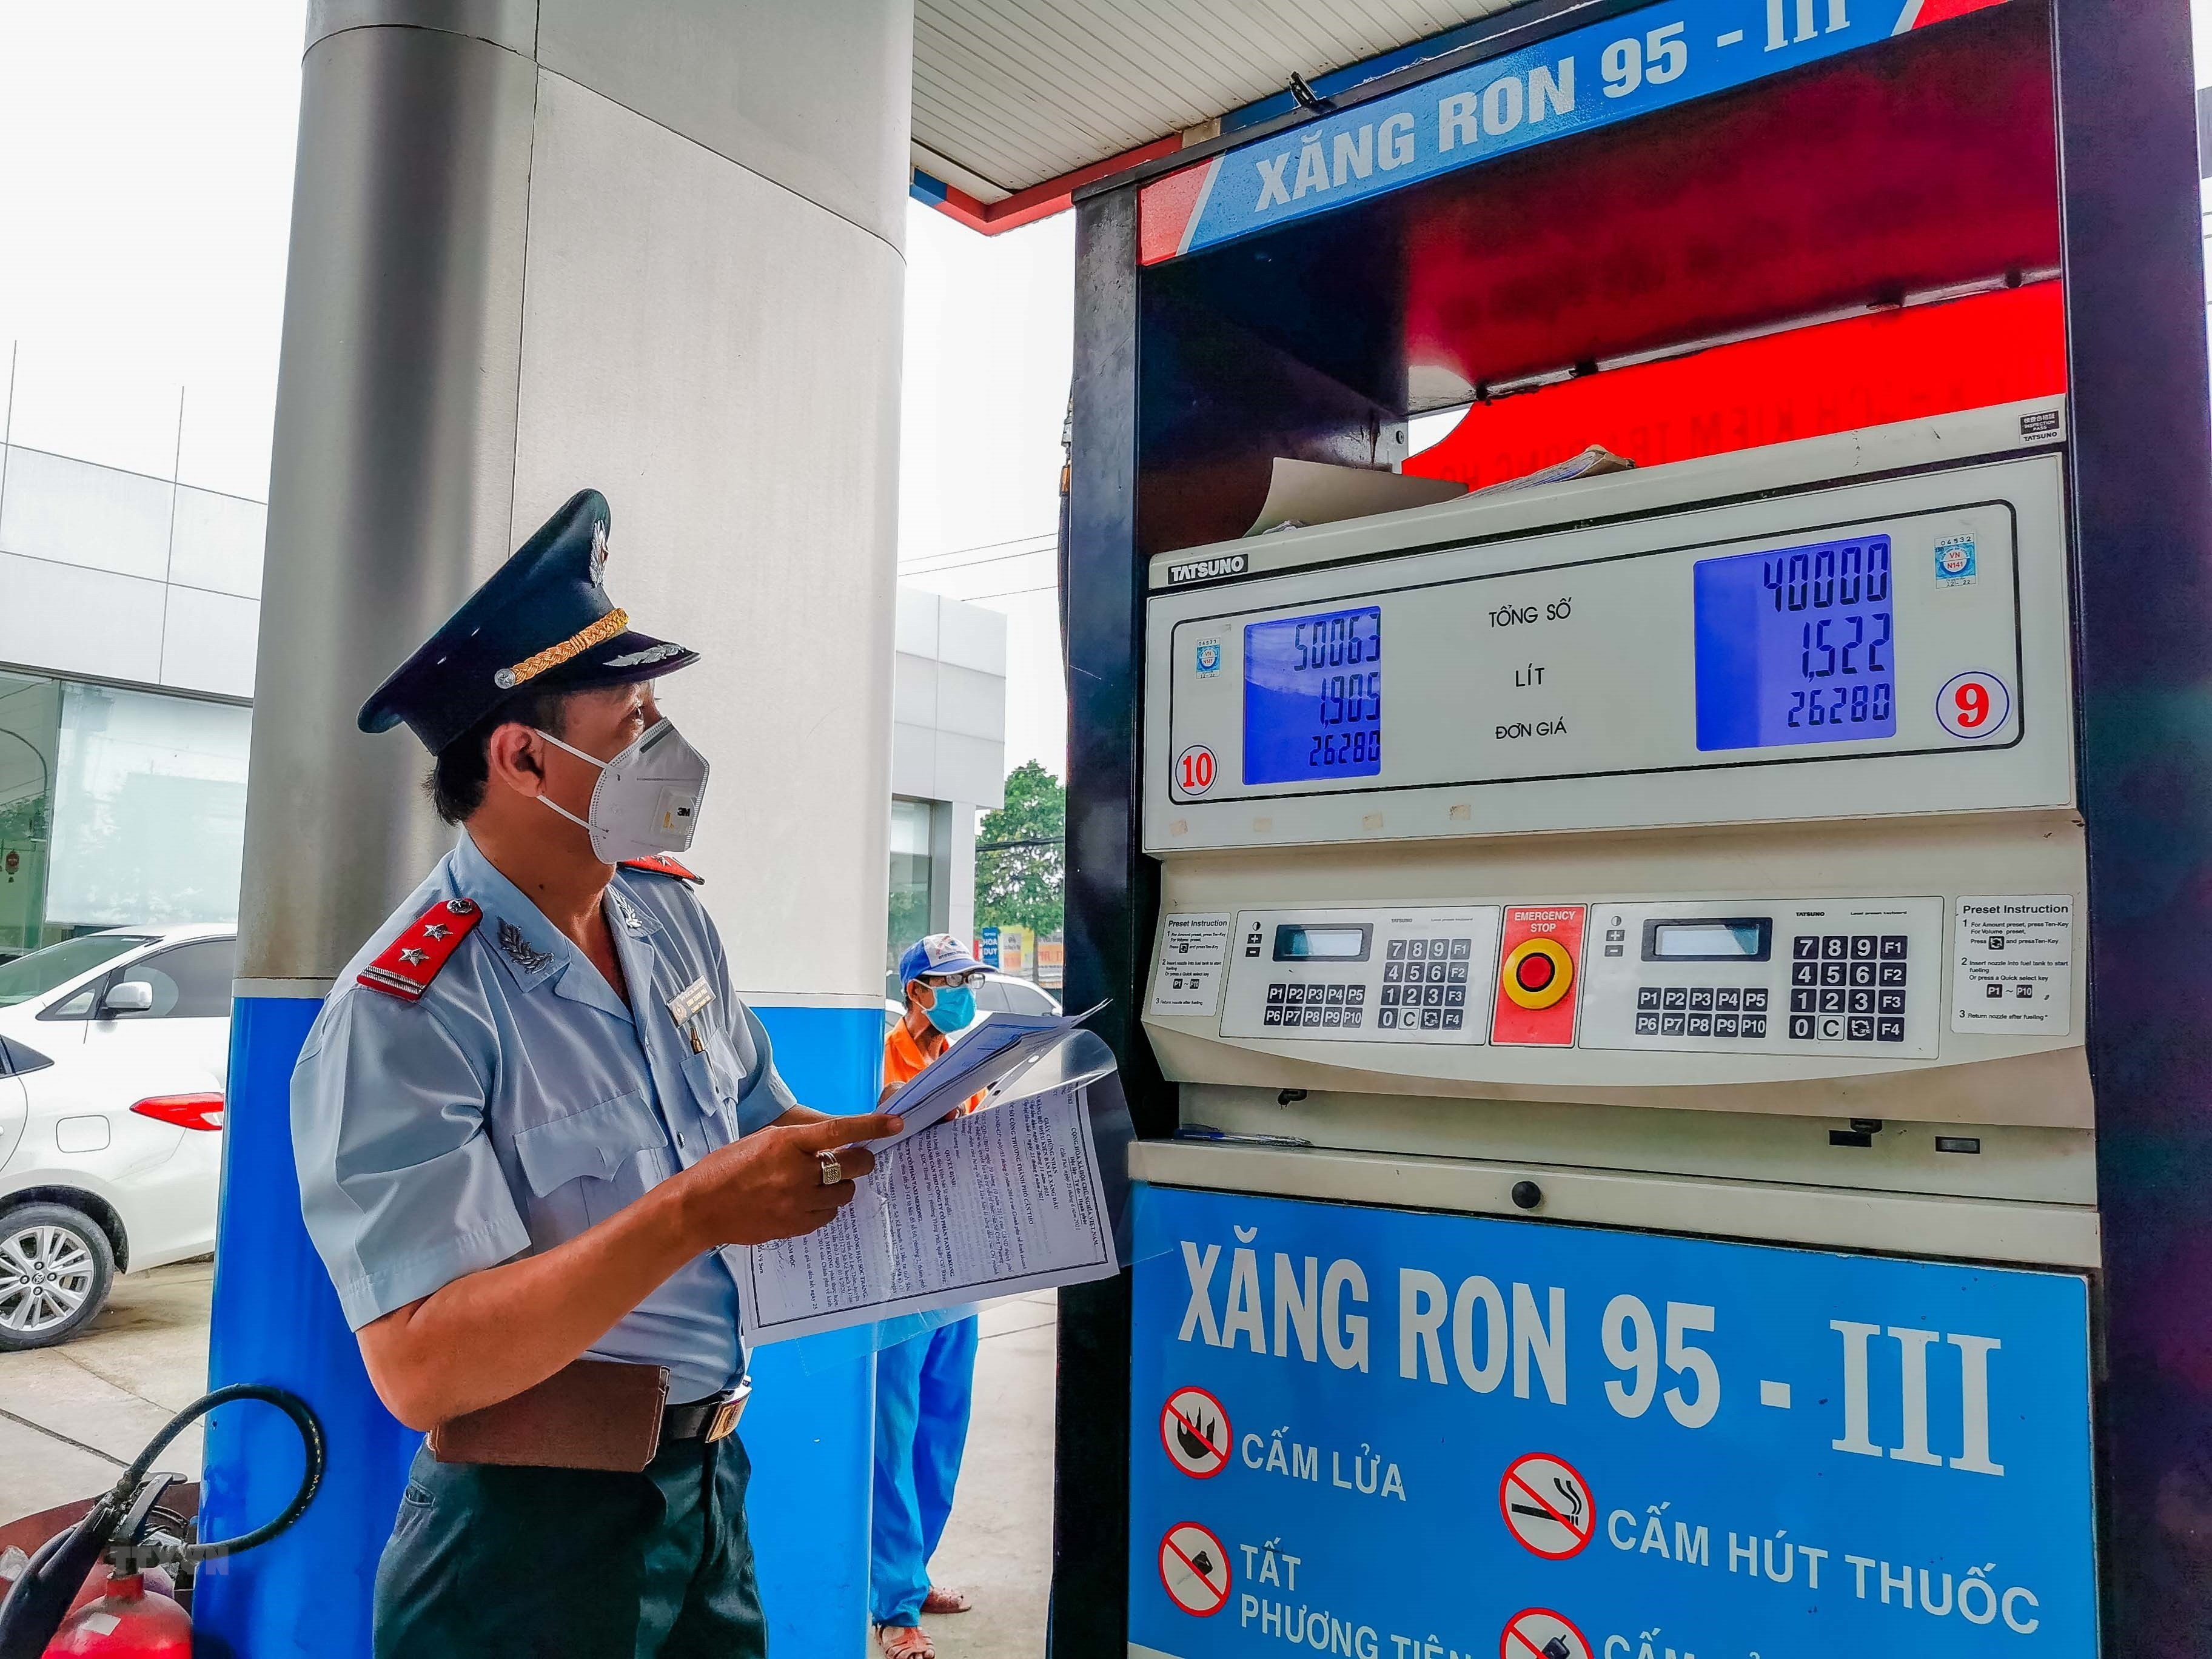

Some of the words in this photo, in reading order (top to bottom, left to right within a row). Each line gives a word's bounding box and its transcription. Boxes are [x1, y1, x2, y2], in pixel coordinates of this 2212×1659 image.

[1255, 112, 1415, 212] XĂNG
[1439, 56, 1575, 153] RON
[1601, 21, 1688, 98] 95
[1717, 29, 1743, 49] -
[2023, 432, 2057, 441] TATSUNO
[1941, 537, 1971, 546] 04532
[1171, 556, 1244, 581] TATSUNO
[1764, 543, 1888, 612] 40000
[1489, 605, 1538, 628] TỔNG
[1546, 597, 1572, 620] SỐ
[1802, 612, 1890, 683] 1,522
[1515, 663, 1544, 687] LÍT
[1788, 683, 1890, 728] 26280
[1954, 682, 1989, 728] 9
[1495, 723, 1531, 739] ĐƠN
[1537, 716, 1567, 736] GIÁ
[1182, 752, 1213, 787] 10
[677, 807, 691, 816] 3M
[1515, 911, 1576, 922] EMERGENCY
[1963, 905, 2000, 914] Preset
[2004, 904, 2068, 913] Instruction
[1530, 923, 1556, 933] STOP
[1392, 943, 1403, 956] 7
[1413, 943, 1423, 957] 8
[1434, 943, 1443, 956] 9
[1454, 945, 1466, 954] F1
[1800, 940, 1813, 956] 7
[1828, 940, 1841, 956] 8
[1857, 940, 1870, 956] 9
[1885, 942, 1901, 953] F1
[1389, 965, 1398, 979] 4
[1410, 965, 1419, 979] 5
[1431, 965, 1441, 980] 6
[1451, 968, 1464, 977] F2
[1798, 967, 1811, 983] 4
[1826, 967, 1840, 983] 5
[1856, 967, 1869, 984] 6
[1884, 970, 1902, 980] F2
[1270, 988, 1282, 999] P1
[1289, 989, 1303, 1000] P2
[1308, 989, 1323, 1000] P3
[1328, 989, 1342, 1000] P4
[1348, 990, 1363, 1000] P5
[1387, 989, 1394, 1002] 1
[1406, 988, 1417, 1003] 2
[1428, 989, 1438, 1004] 3
[1449, 991, 1462, 1000] F3
[1641, 993, 1657, 1004] P1
[1666, 993, 1684, 1005] P2
[1692, 993, 1711, 1005] P3
[1719, 993, 1737, 1006] P4
[1746, 994, 1765, 1007] P5
[1798, 992, 1806, 1009] 1
[1825, 993, 1838, 1010] 2
[1855, 993, 1868, 1010] 3
[1883, 996, 1901, 1007] F3
[1266, 1011, 1281, 1021] P6
[1285, 1011, 1300, 1022] P7
[1305, 1011, 1319, 1022] P8
[1325, 1012, 1339, 1022] P9
[1344, 1012, 1361, 1024] P10
[1383, 1012, 1392, 1026] 0
[1404, 1013, 1415, 1027] C
[1446, 1014, 1459, 1024] F4
[1638, 1018, 1656, 1030] P6
[1664, 1018, 1683, 1030] P7
[1691, 1019, 1709, 1031] P8
[1717, 1020, 1736, 1032] P9
[1743, 1021, 1765, 1033] P10
[1795, 1019, 1808, 1036] 0
[1823, 1020, 1839, 1037] C
[1882, 1024, 1900, 1034] F4
[1178, 1225, 1369, 1373] XĂNG
[1399, 1267, 1567, 1406] RON
[1601, 1294, 1721, 1429] 95
[1760, 1379, 1791, 1409] -
[1829, 1319, 2005, 1476] III
[1242, 1426, 1318, 1481] CẤM
[1333, 1443, 1406, 1501] LỬA
[1240, 1537, 1301, 1591] TẤT
[1607, 1501, 1709, 1567] CẤM
[1728, 1529, 1829, 1589] HÚT
[1844, 1562, 2039, 1635] THUỐC
[1241, 1592, 1378, 1659] PHƯƠNG
